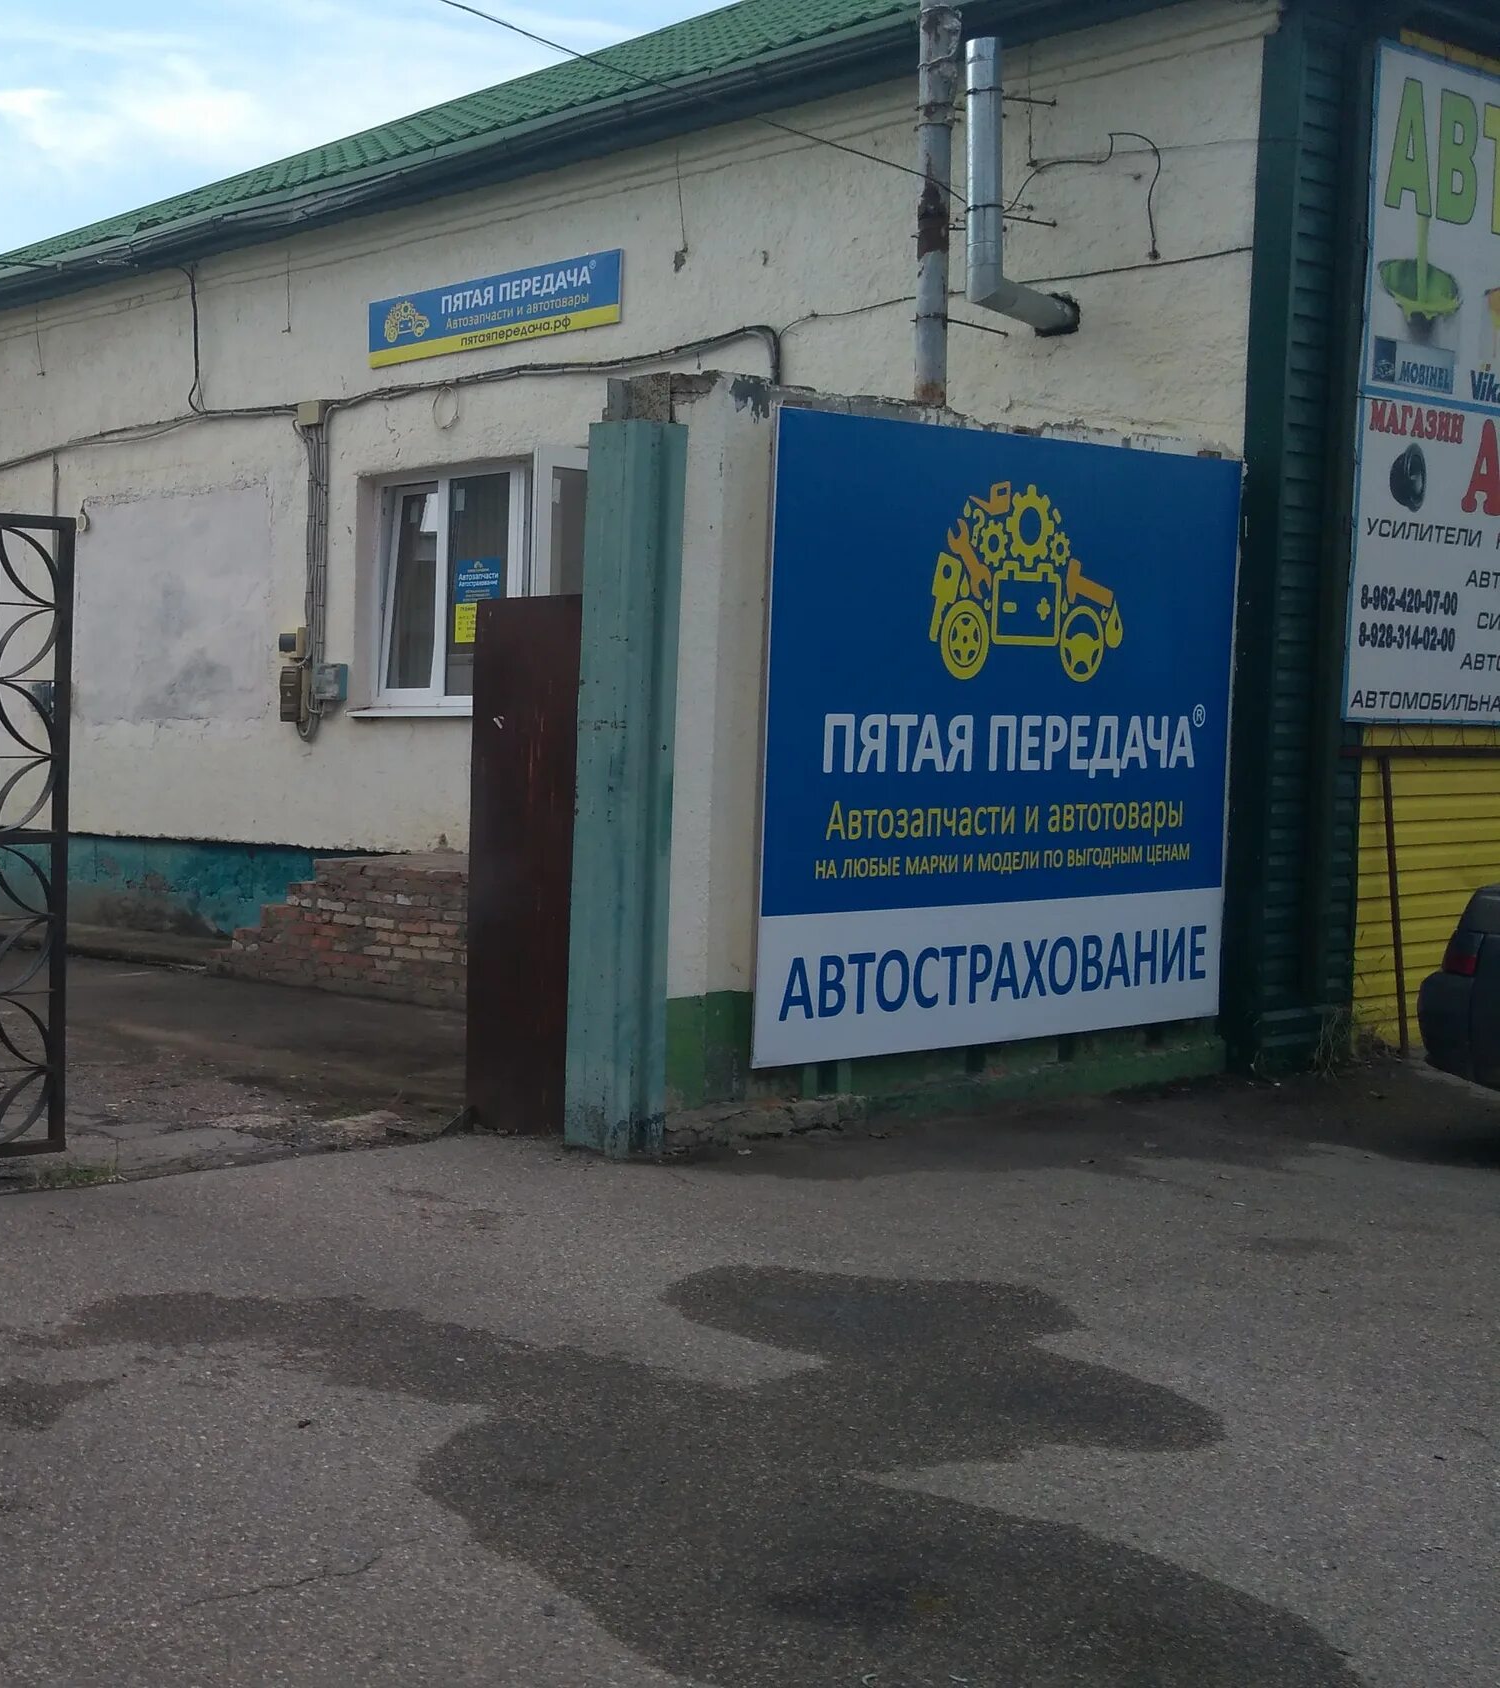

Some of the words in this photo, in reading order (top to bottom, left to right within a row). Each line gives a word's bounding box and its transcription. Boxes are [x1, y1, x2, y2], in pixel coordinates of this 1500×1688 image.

[441, 286, 493, 314] ПЯТАЯ
[445, 307, 513, 330] Автозапчасти
[516, 305, 524, 316] и
[526, 293, 589, 315] автотовары
[460, 316, 571, 346] пятаяпередача.рф
[1470, 364, 1500, 404] Vik
[1369, 400, 1465, 444] МАГАЗИН
[1367, 517, 1482, 548] УСИЛИТЕЛИ
[1361, 584, 1458, 616] 8-962-420-07-00
[1358, 621, 1456, 652] 8-928-314-02-00
[823, 713, 974, 774] ПЯТАЯ
[825, 800, 1015, 841] Автозапчасти
[1025, 805, 1039, 834] и
[1048, 800, 1184, 837] автотовары
[815, 859, 837, 880] НА
[841, 856, 900, 879] ЛЮБЫЕ
[905, 853, 959, 876] МАРКИ
[963, 853, 973, 874] И
[978, 850, 1040, 875] МОДЕЛИ
[1043, 848, 1063, 869] ПО
[1067, 845, 1143, 869] ВЫГОДНЫМ
[1147, 842, 1190, 866] ЦЕНАМ
[778, 925, 1208, 1022] АВТОСТРАХОВАНИЕ
